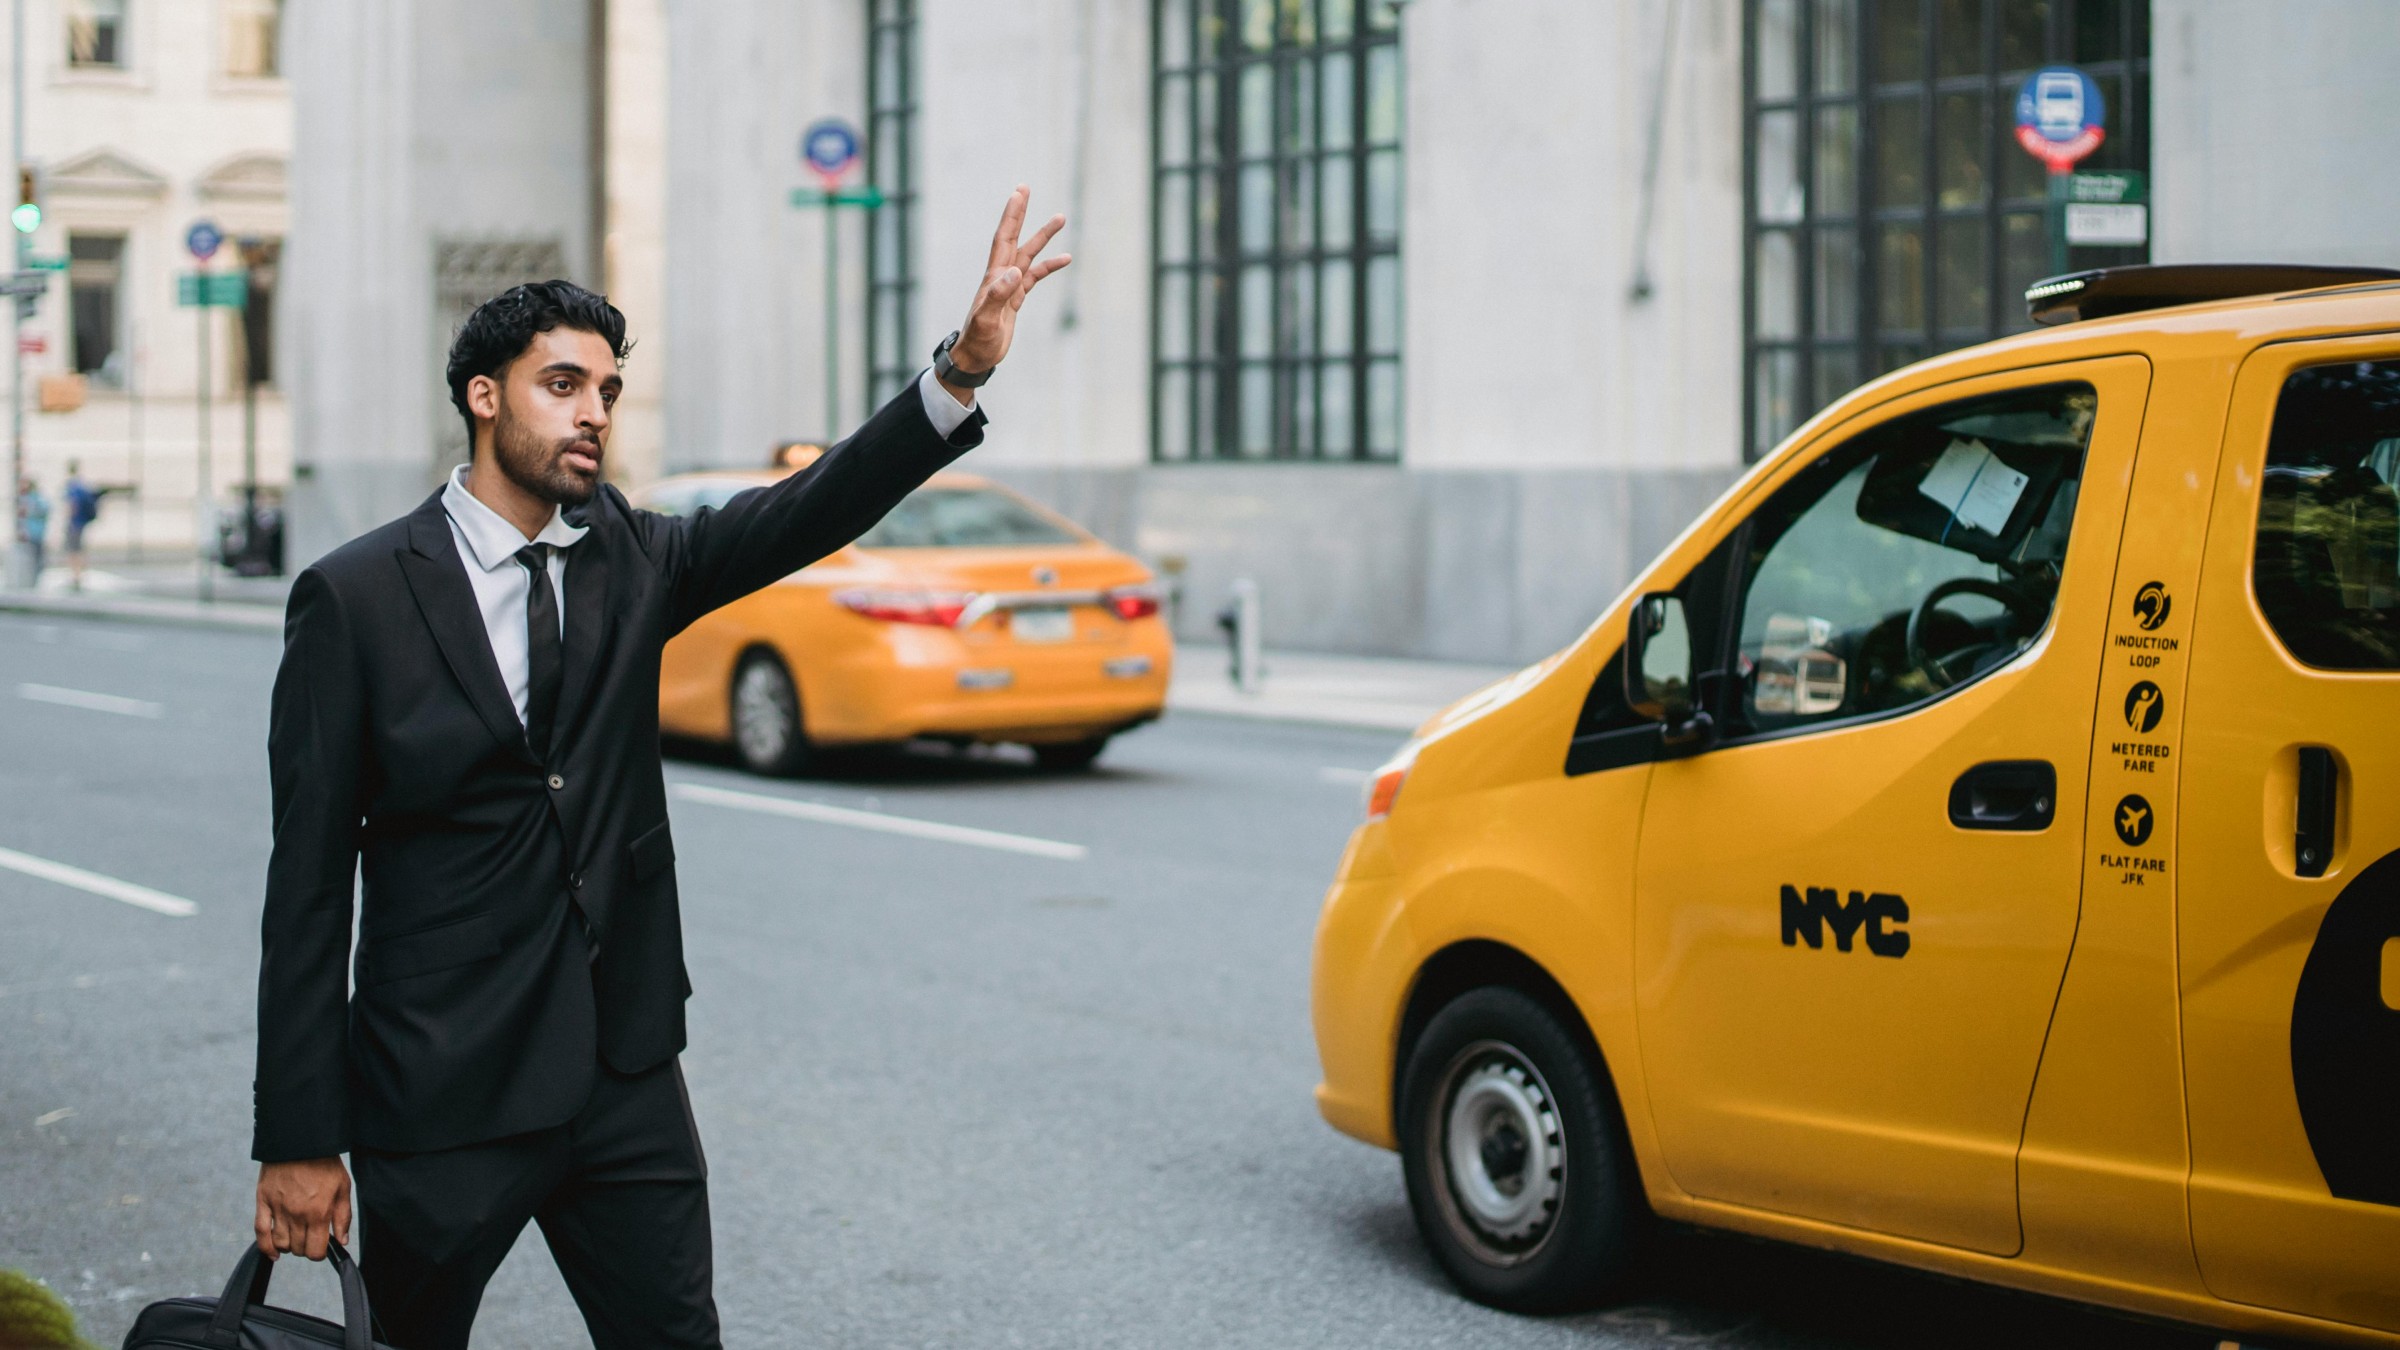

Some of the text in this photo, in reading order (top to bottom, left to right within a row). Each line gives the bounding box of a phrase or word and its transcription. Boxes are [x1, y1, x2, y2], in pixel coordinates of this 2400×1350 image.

[2115, 635, 2178, 650] INDUCTION
[2130, 655, 2160, 668] LOOP
[2112, 743, 2169, 758] METERED
[2124, 759, 2154, 773] FARE
[2101, 855, 2165, 872] FLAT FARE
[2121, 873, 2144, 885] JFK
[1781, 884, 1910, 959] NYC
